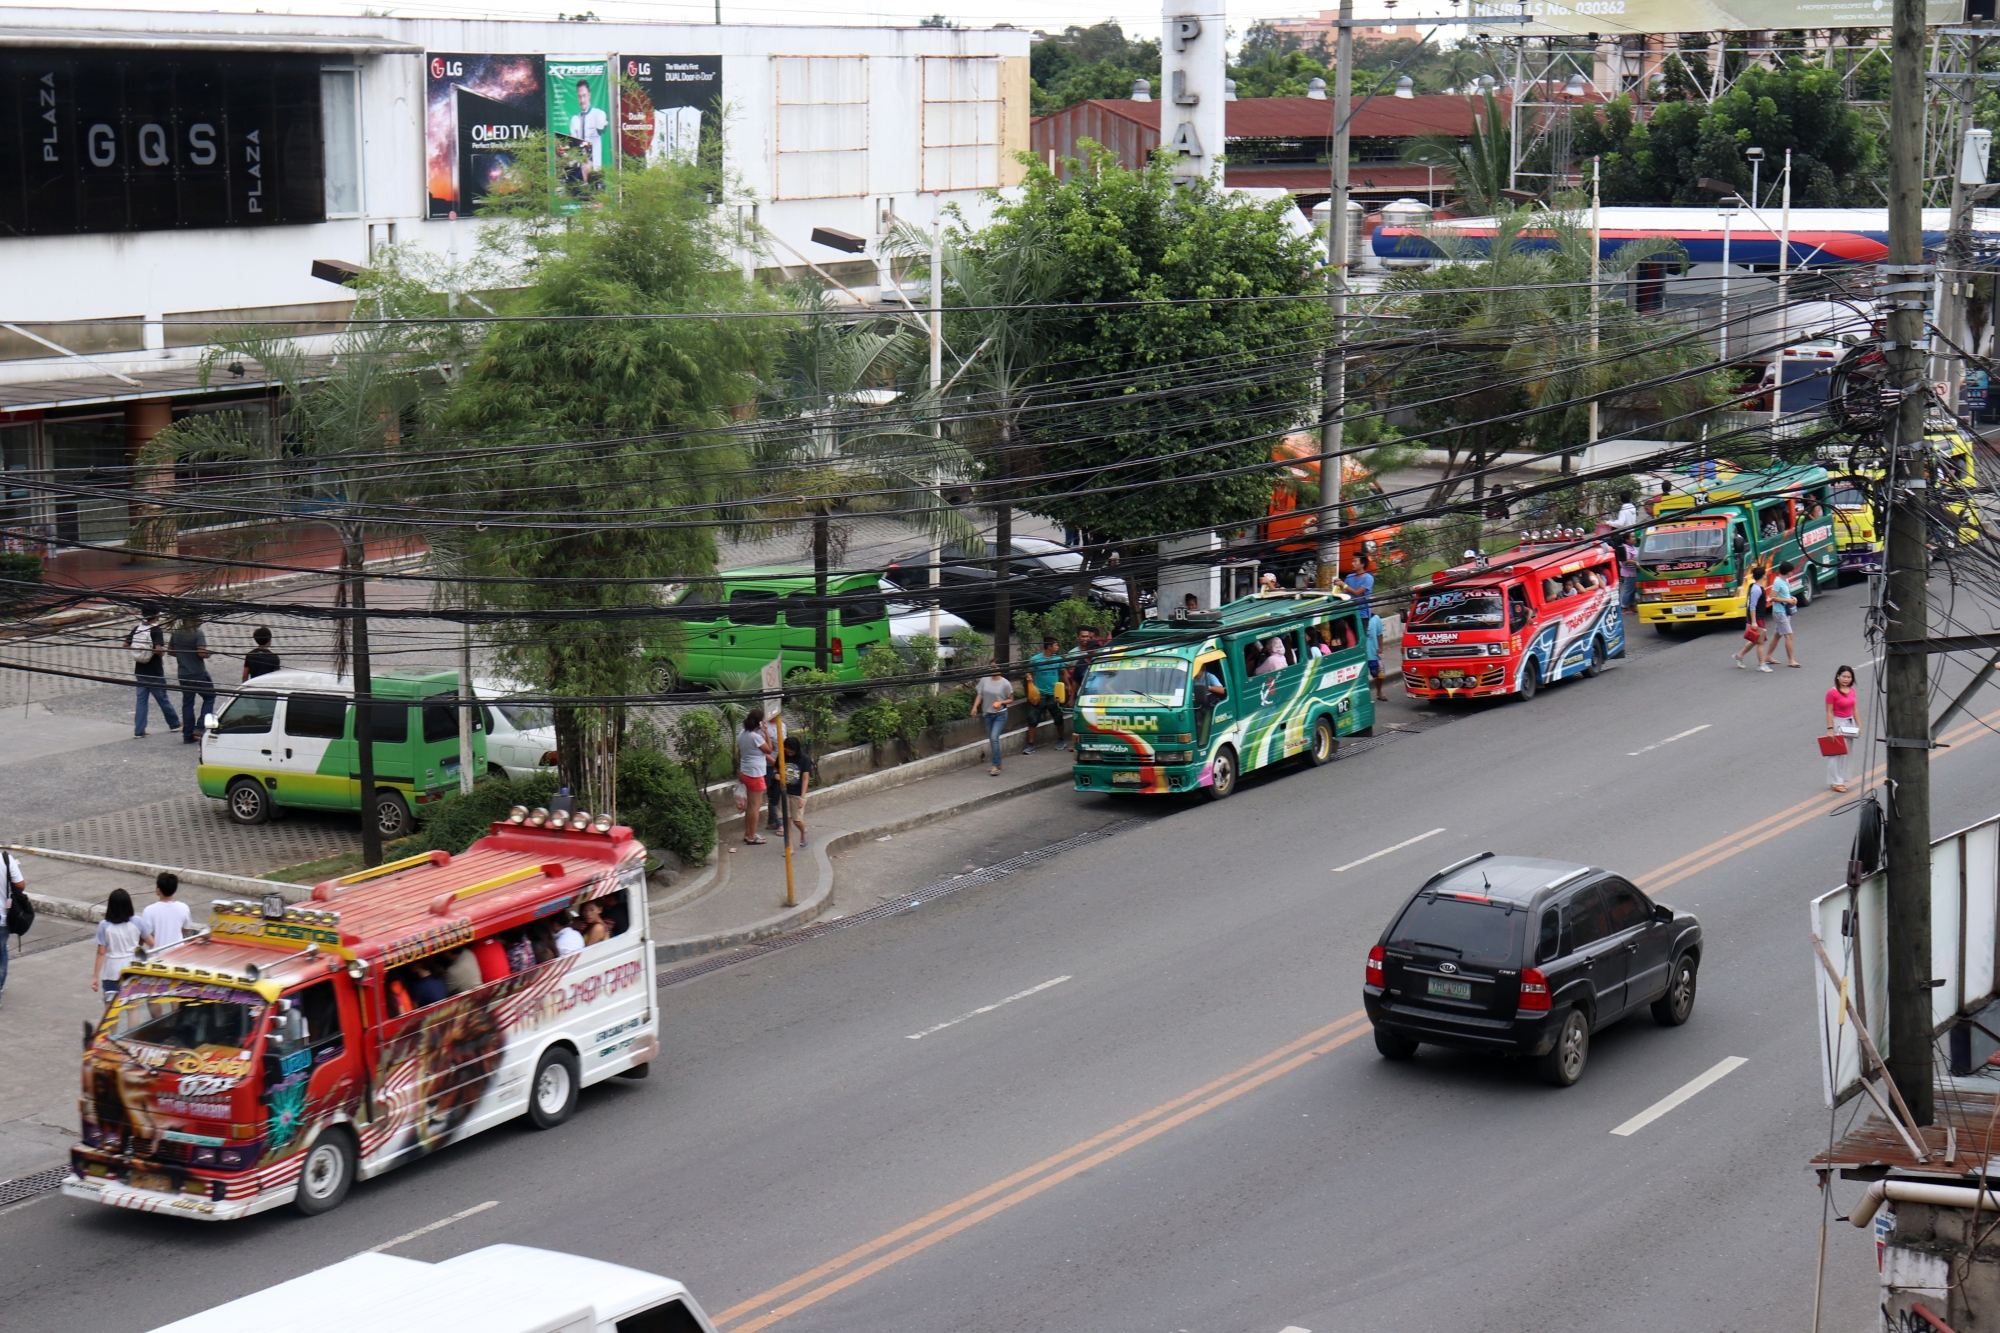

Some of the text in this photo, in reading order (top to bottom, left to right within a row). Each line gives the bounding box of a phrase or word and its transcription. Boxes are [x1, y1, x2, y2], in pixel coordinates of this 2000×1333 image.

[1475, 1, 1625, 16] HLURB LS No. 030362
[446, 61, 463, 76] LG
[548, 65, 605, 79] XTREME
[638, 62, 652, 75] LG
[665, 72, 681, 81] DUAL
[40, 72, 59, 161] PLAZA
[471, 125, 510, 141] OLED
[510, 124, 529, 139] TV
[246, 129, 263, 213] PLAZA
[1667, 578, 1697, 586] ISUZU
[1416, 633, 1459, 641] TALAMBAN
[265, 922, 339, 944] COSMOS
[1432, 980, 1468, 994] YHC 900
